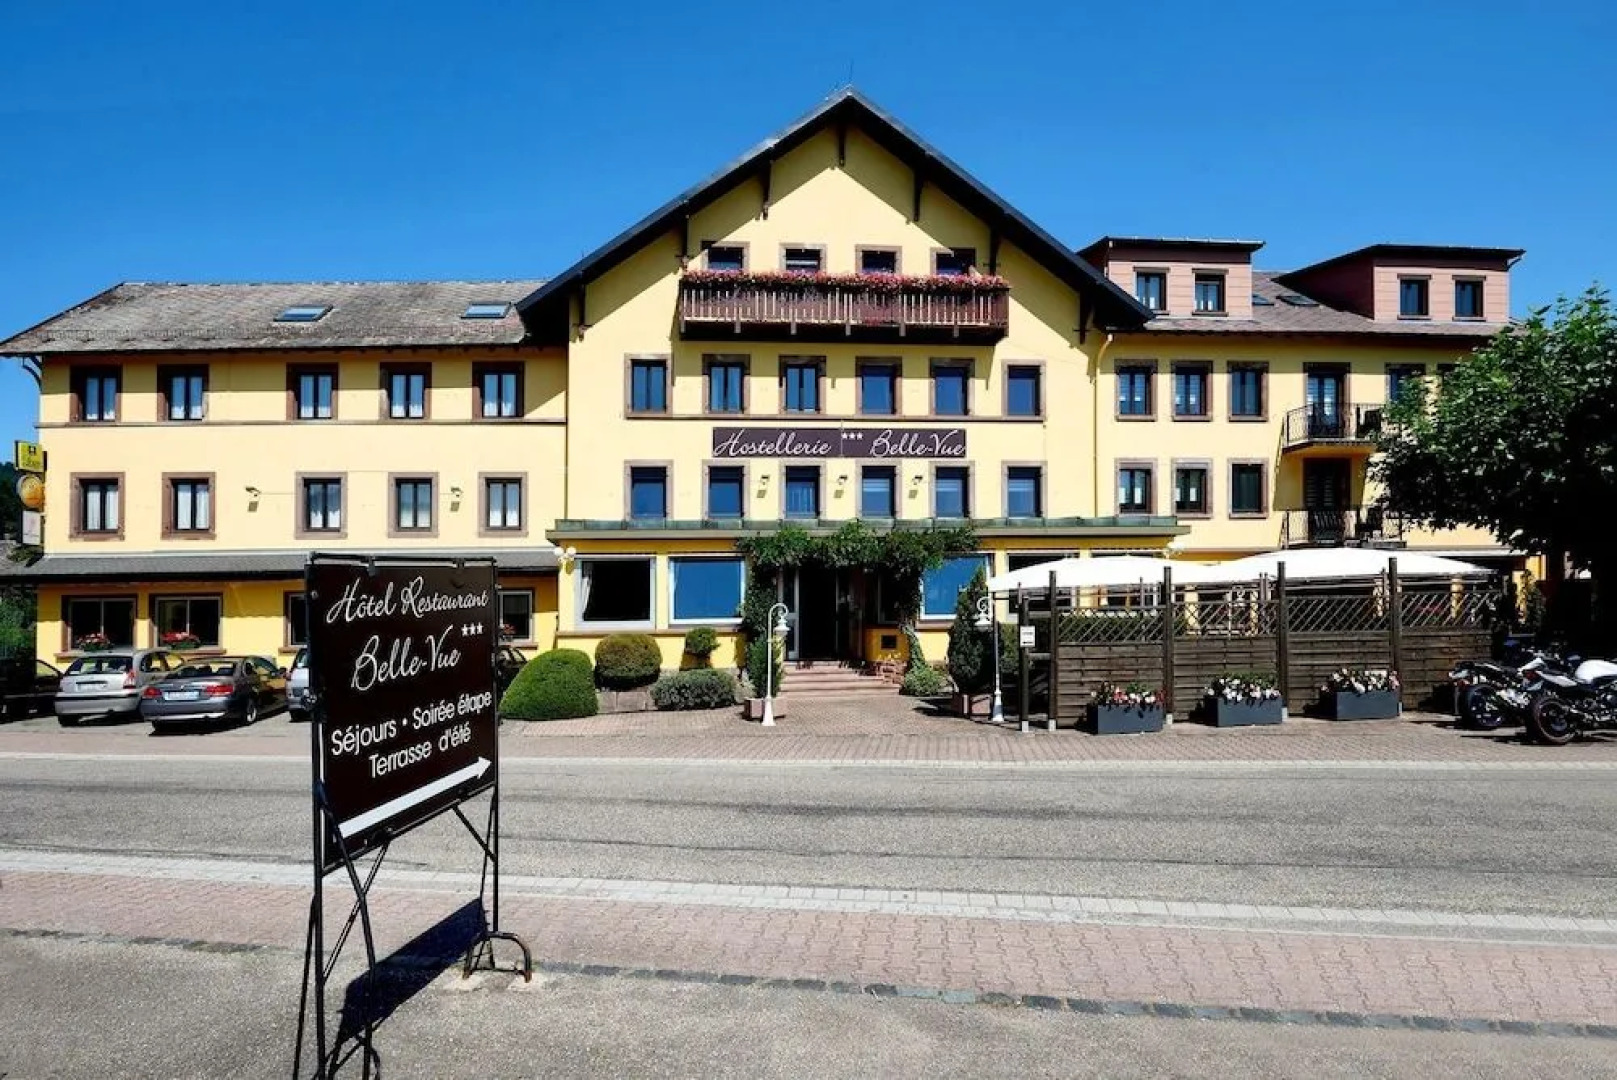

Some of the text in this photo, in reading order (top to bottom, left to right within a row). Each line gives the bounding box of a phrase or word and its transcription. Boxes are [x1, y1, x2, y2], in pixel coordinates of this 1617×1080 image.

[713, 428, 966, 457] Hostellerie Belle-Vue
[326, 576, 489, 624] Hôtel Restaurant
[351, 624, 461, 691] Belle-Vue
[331, 691, 492, 756] Séjours Soirée étape
[368, 721, 471, 778] Terrasse d'été
